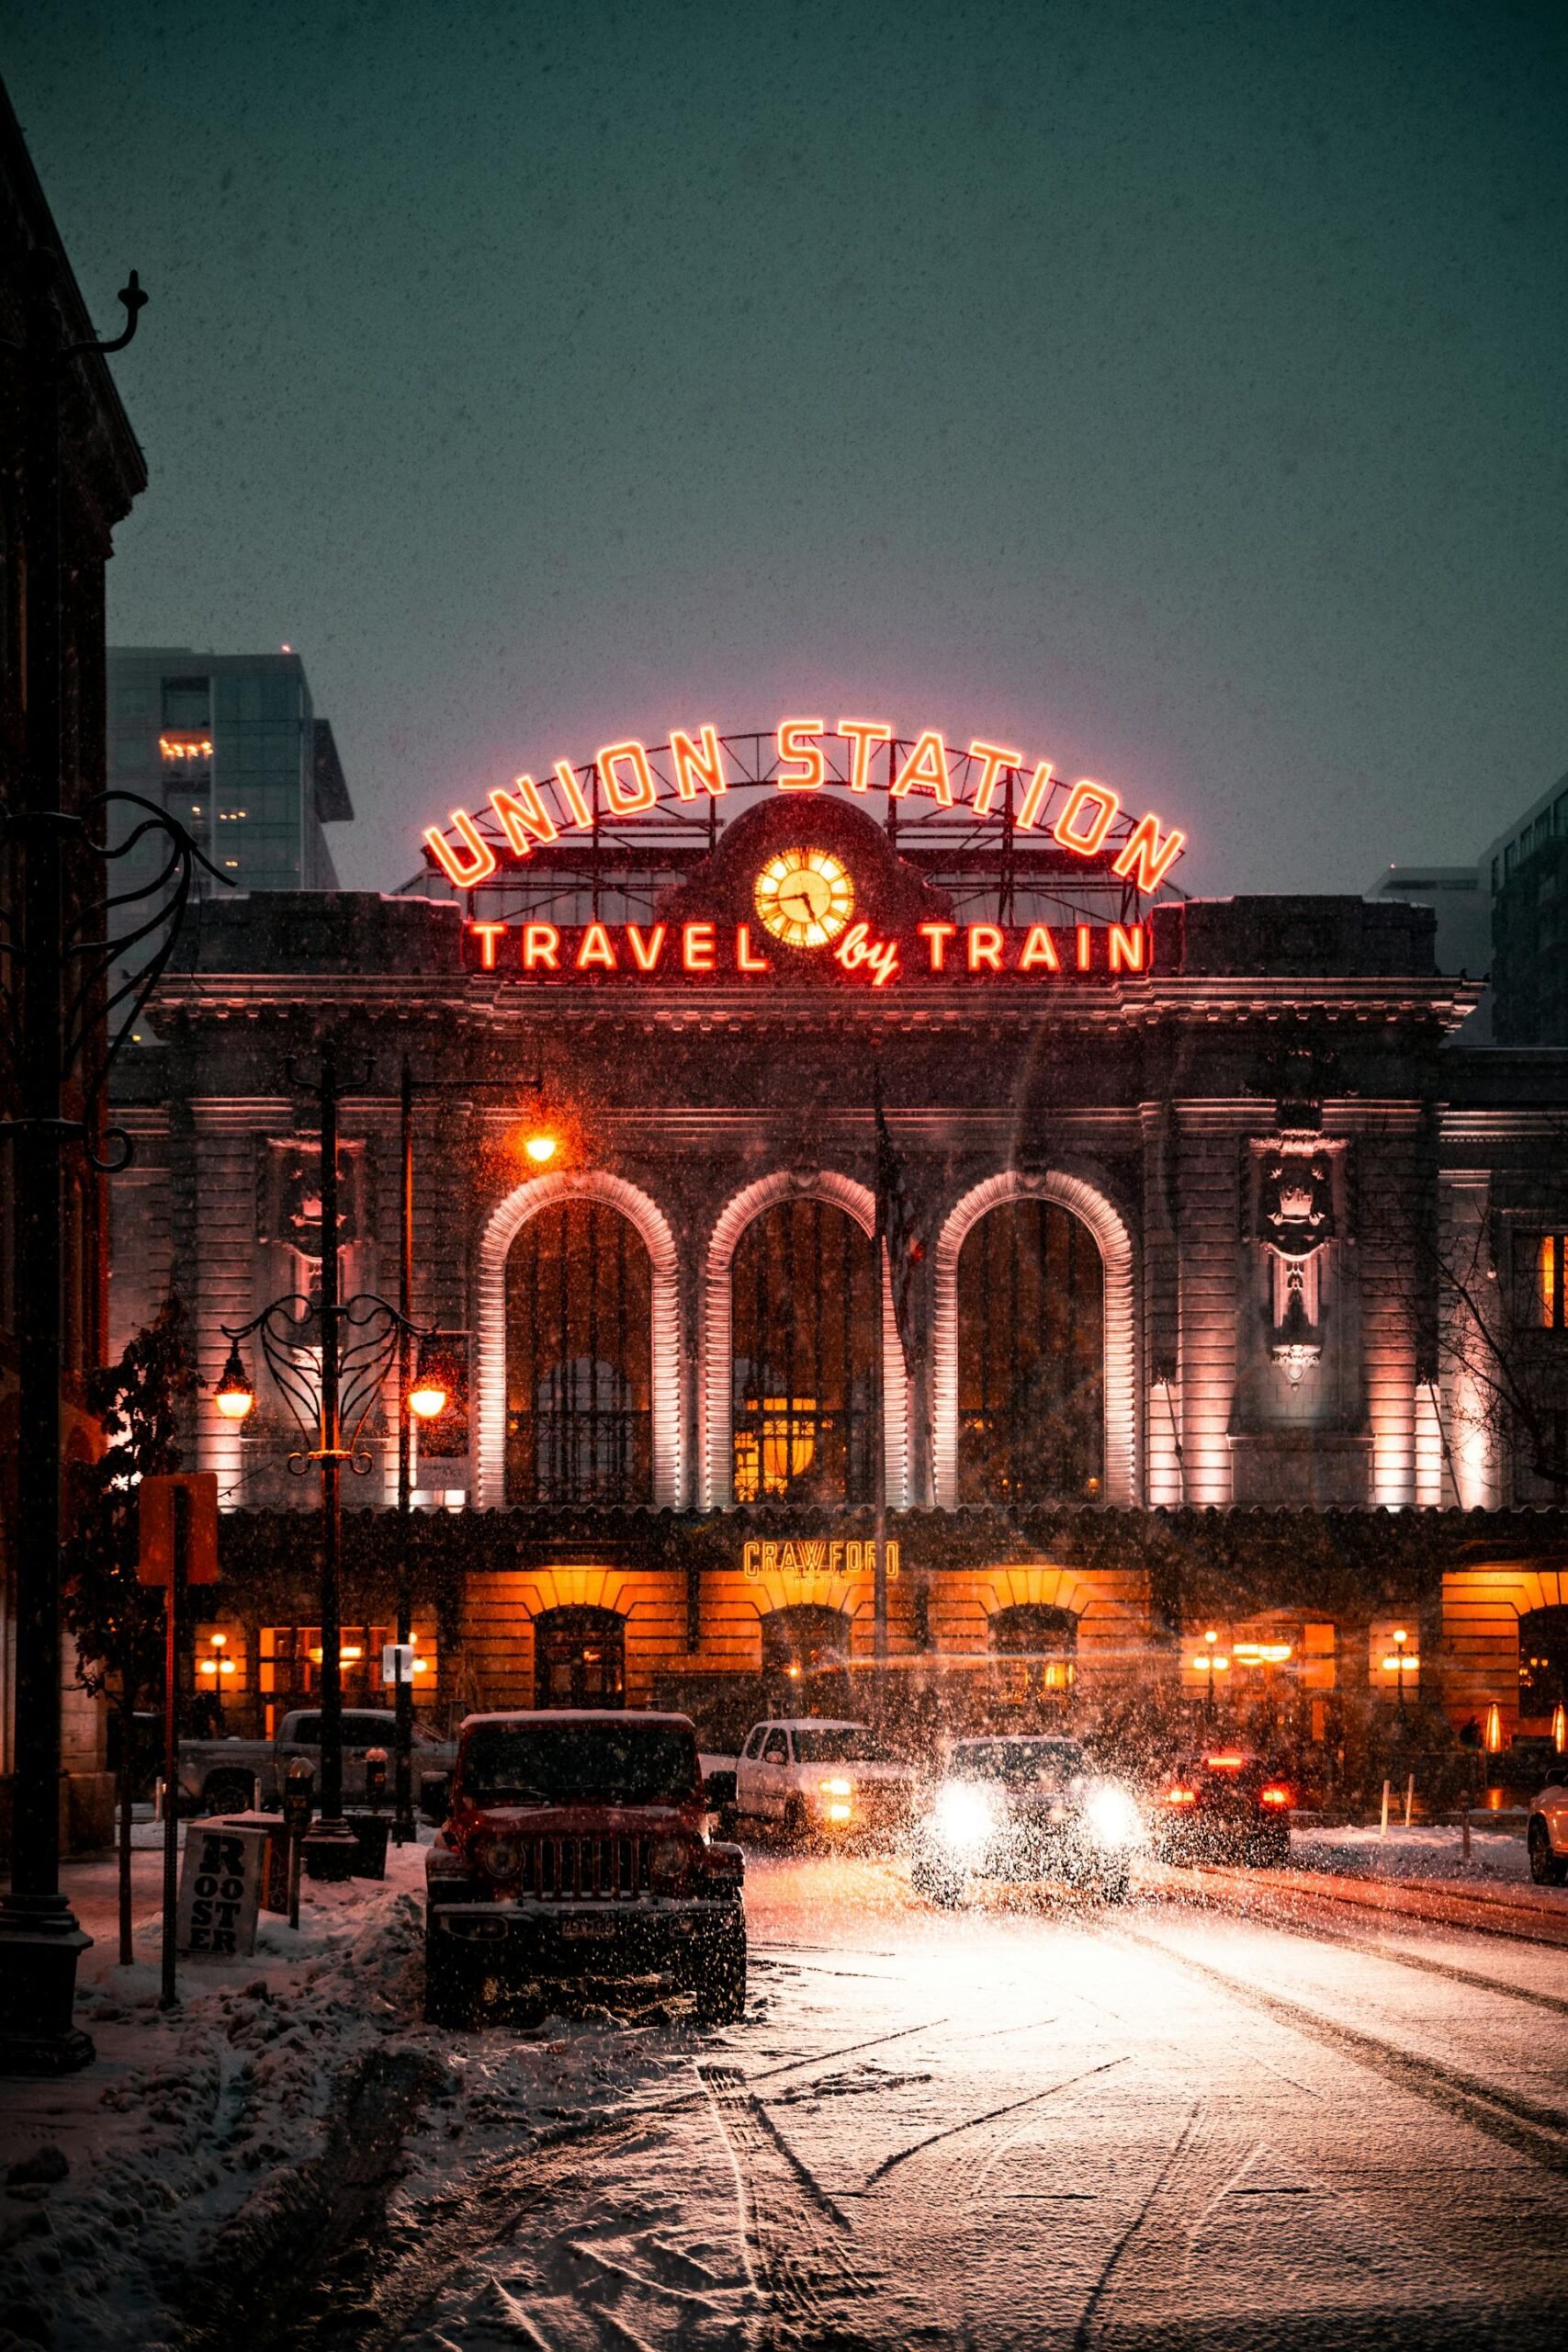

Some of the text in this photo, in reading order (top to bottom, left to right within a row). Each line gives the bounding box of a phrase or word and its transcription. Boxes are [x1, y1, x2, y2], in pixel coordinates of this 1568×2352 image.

[423, 718, 1185, 895] UNION STATION
[470, 922, 1145, 986] TRAVEL by TRAIN
[744, 1541, 899, 1578] CRAWFORD
